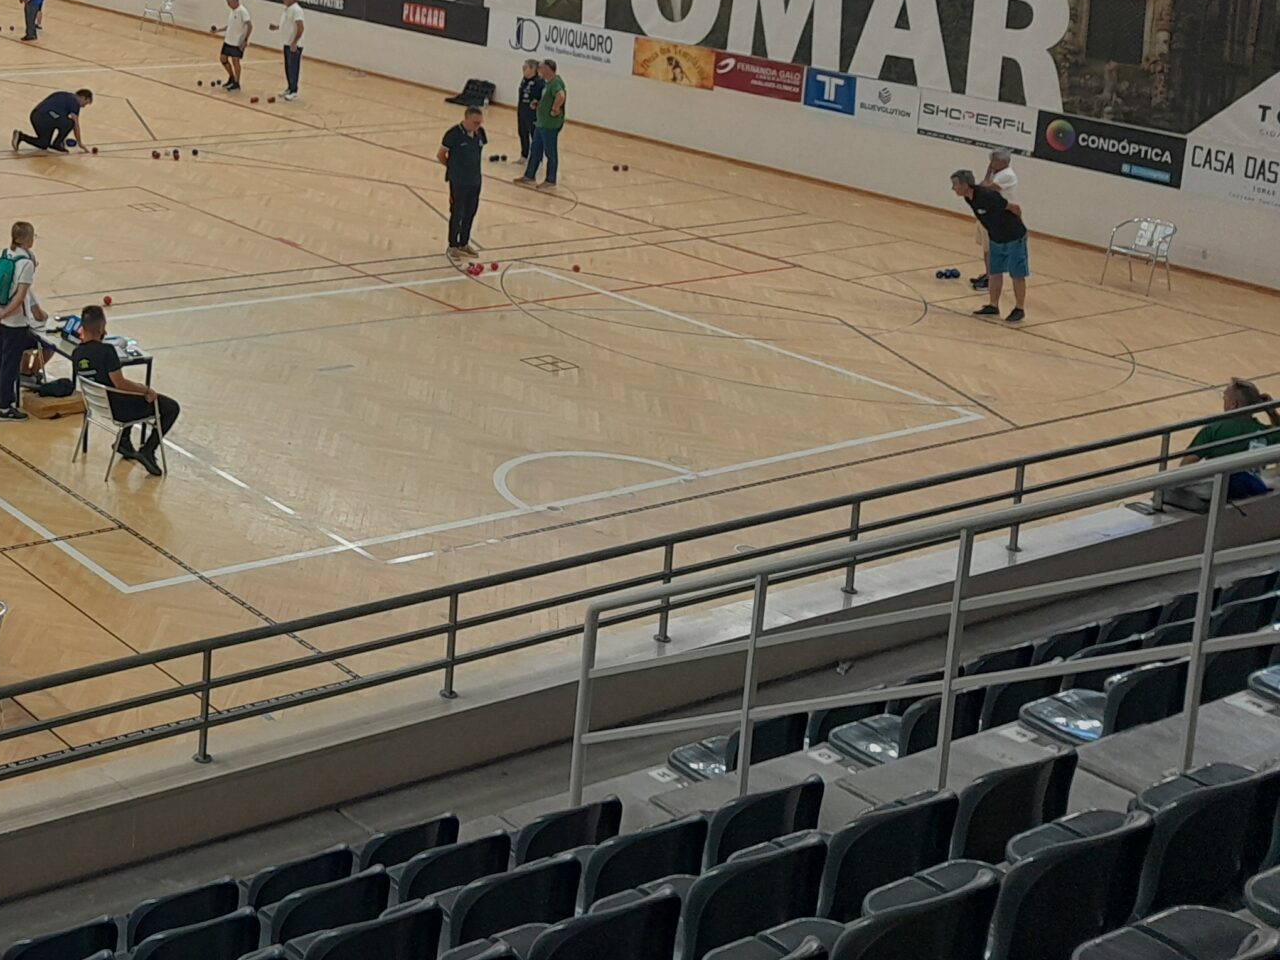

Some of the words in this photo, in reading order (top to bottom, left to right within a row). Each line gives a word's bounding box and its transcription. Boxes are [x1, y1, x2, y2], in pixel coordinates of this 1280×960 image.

[403, 3, 446, 29] PLACARD
[545, 24, 613, 55] JOVIQUADRO
[737, 62, 777, 77] FERNANDA
[779, 68, 801, 81] GALO
[860, 102, 911, 119] BLUEVOLUTION
[1078, 133, 1172, 164] CONDÓPTICA
[1191, 145, 1234, 175] CASA
[1244, 155, 1280, 184] DAS
